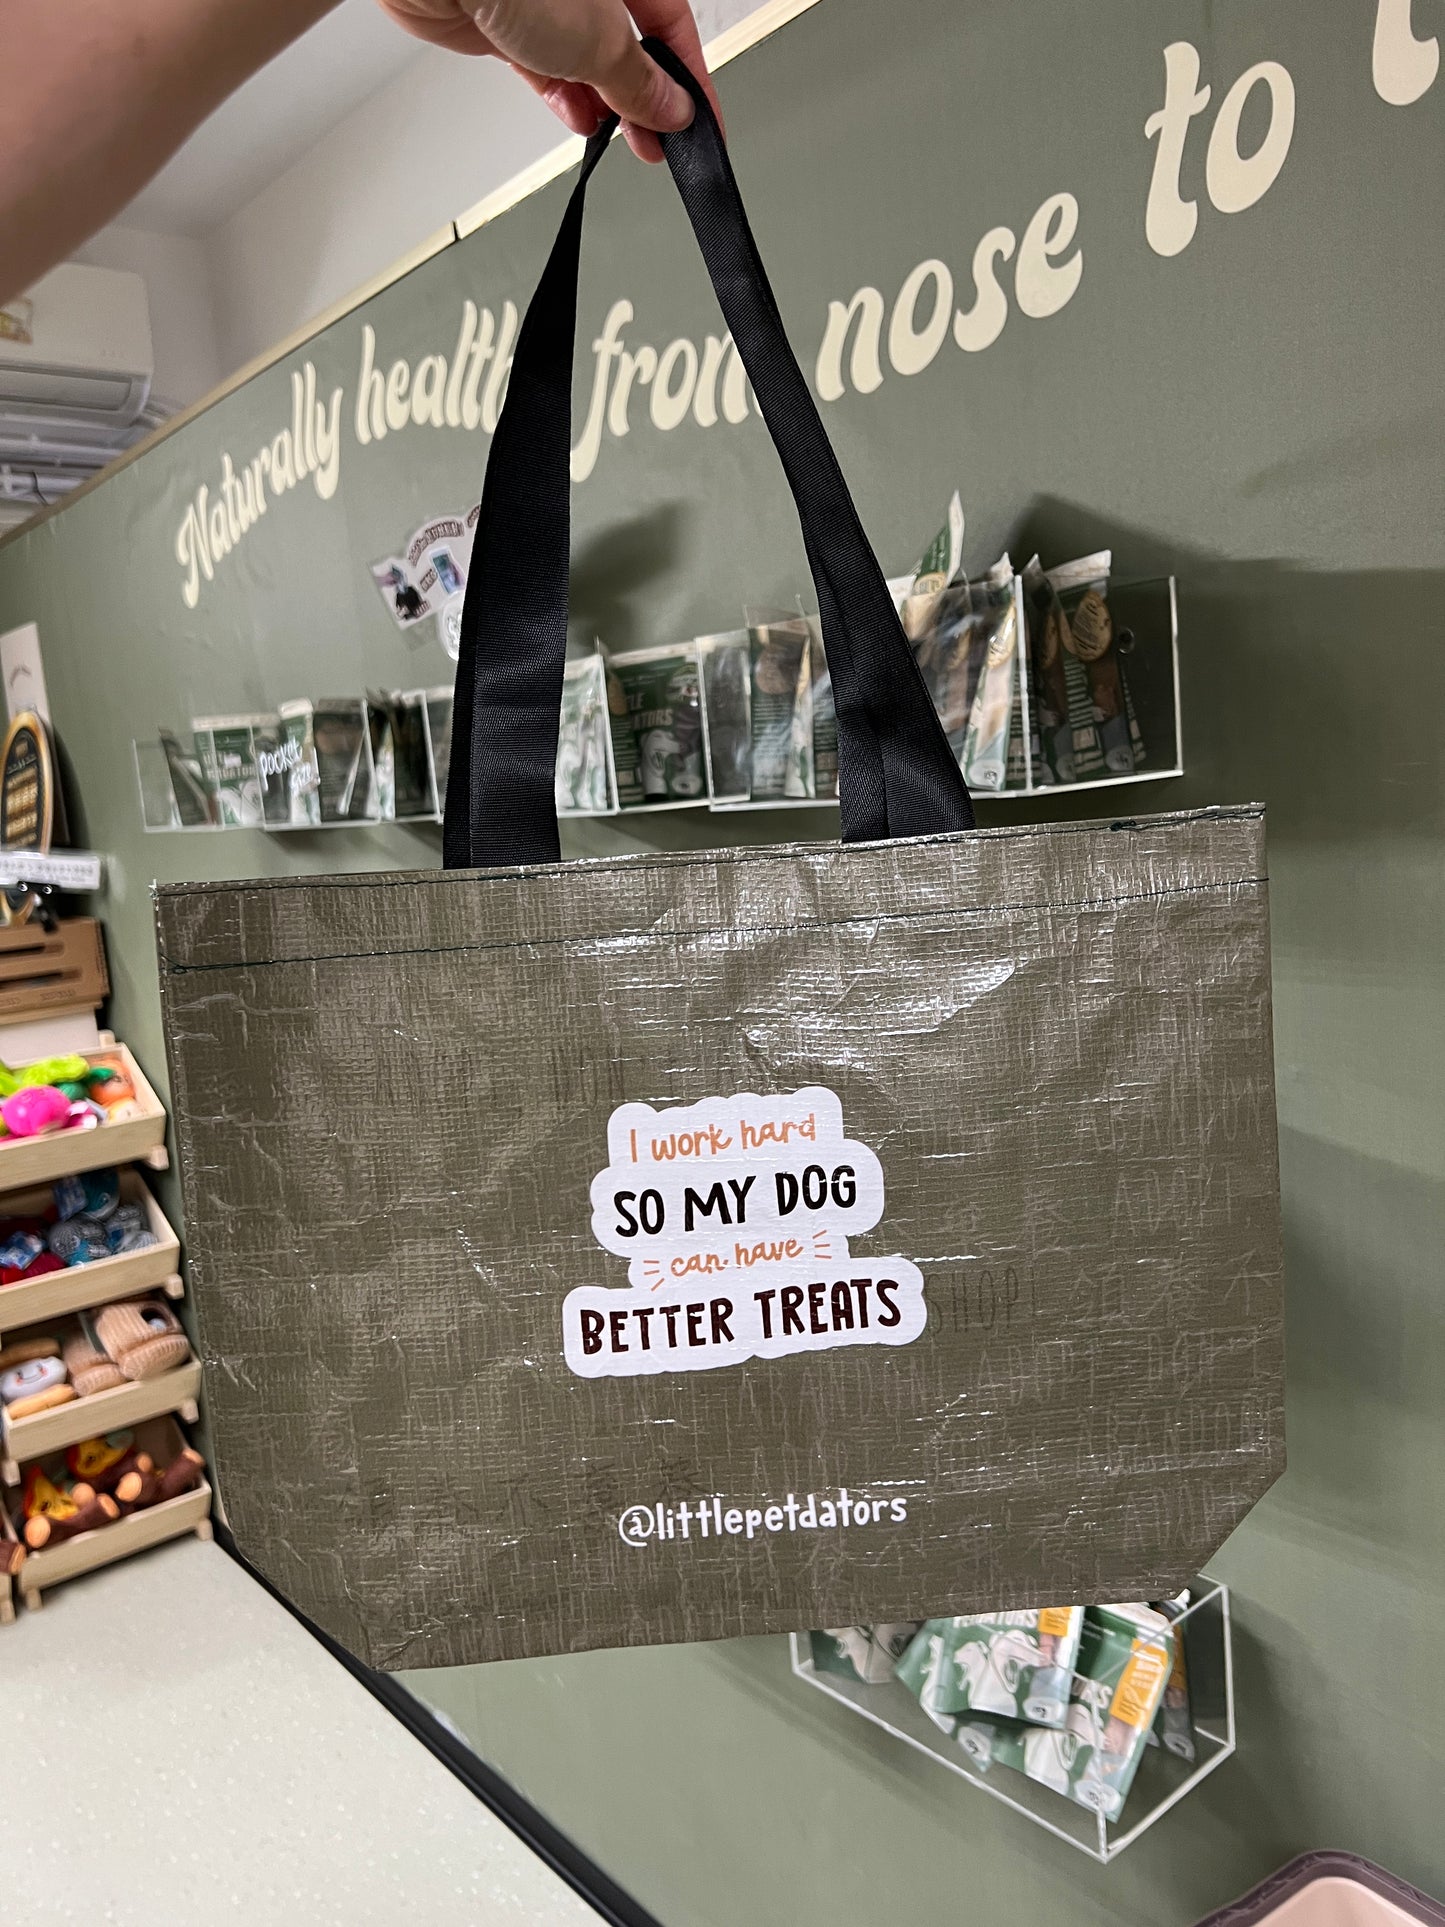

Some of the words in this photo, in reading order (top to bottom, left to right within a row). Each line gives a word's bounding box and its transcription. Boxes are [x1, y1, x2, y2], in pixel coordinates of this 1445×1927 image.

[174, 360, 344, 609] Naturally
[815, 192, 1083, 402] nose
[1144, 41, 1296, 257] to
[629, 1128, 639, 1164] I
[651, 1125, 733, 1161] work
[740, 1113, 818, 1149] hard
[614, 1188, 666, 1239] SO
[684, 1176, 757, 1233] MY
[774, 1164, 858, 1218] DOG
[670, 1255, 728, 1277] can
[735, 1238, 804, 1268] have
[580, 1298, 735, 1356] BETTER
[753, 1278, 903, 1341] TREATS
[617, 1487, 908, 1548] @littlepetdators
